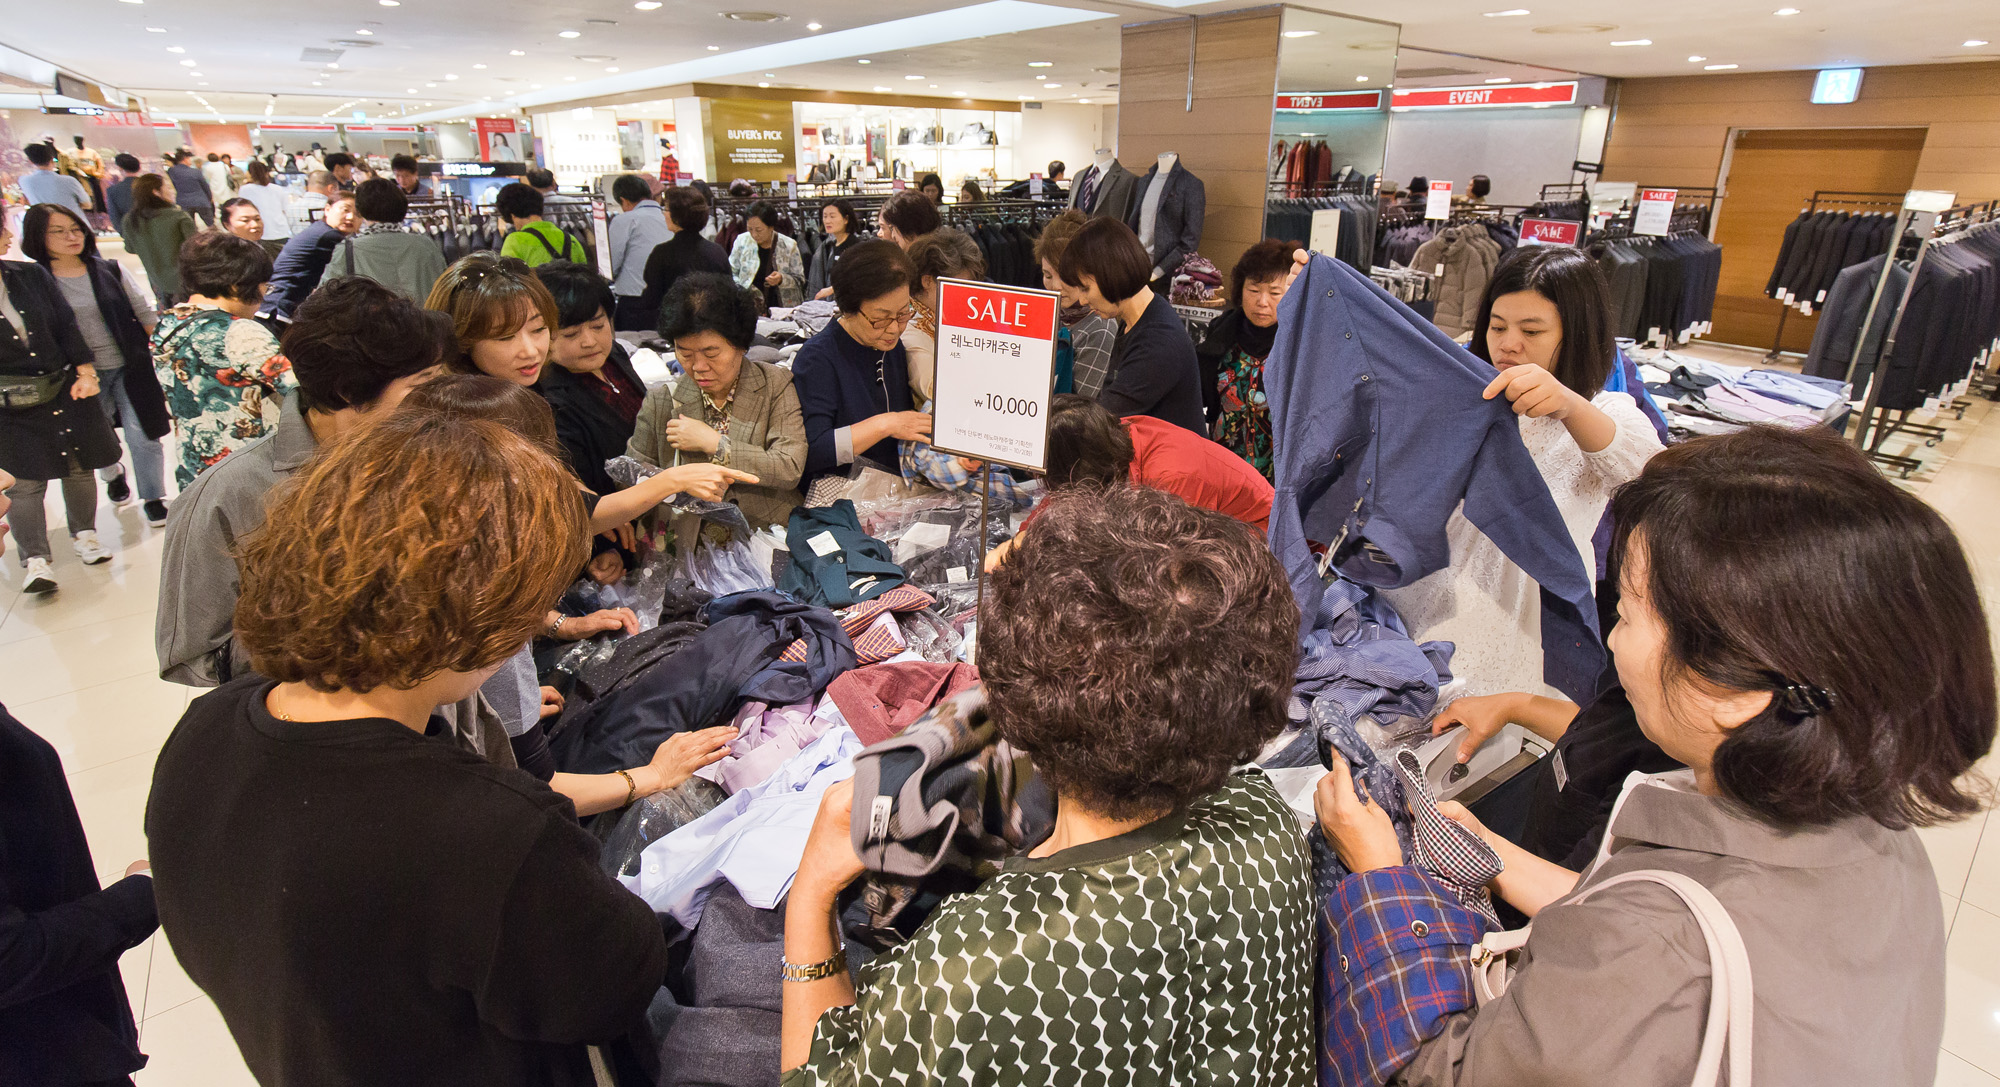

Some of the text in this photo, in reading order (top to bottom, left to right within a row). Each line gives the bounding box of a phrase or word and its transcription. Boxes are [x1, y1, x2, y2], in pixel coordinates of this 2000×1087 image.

[1449, 90, 1493, 104] EVENT
[763, 130, 783, 140] PICK
[1649, 191, 1668, 200] SALE
[1533, 224, 1565, 239] SALE
[967, 296, 1028, 327] SALE
[1176, 308, 1214, 318] ENOMA
[951, 334, 1021, 357] 레노마캐주얼
[949, 351, 961, 359] 셔츠
